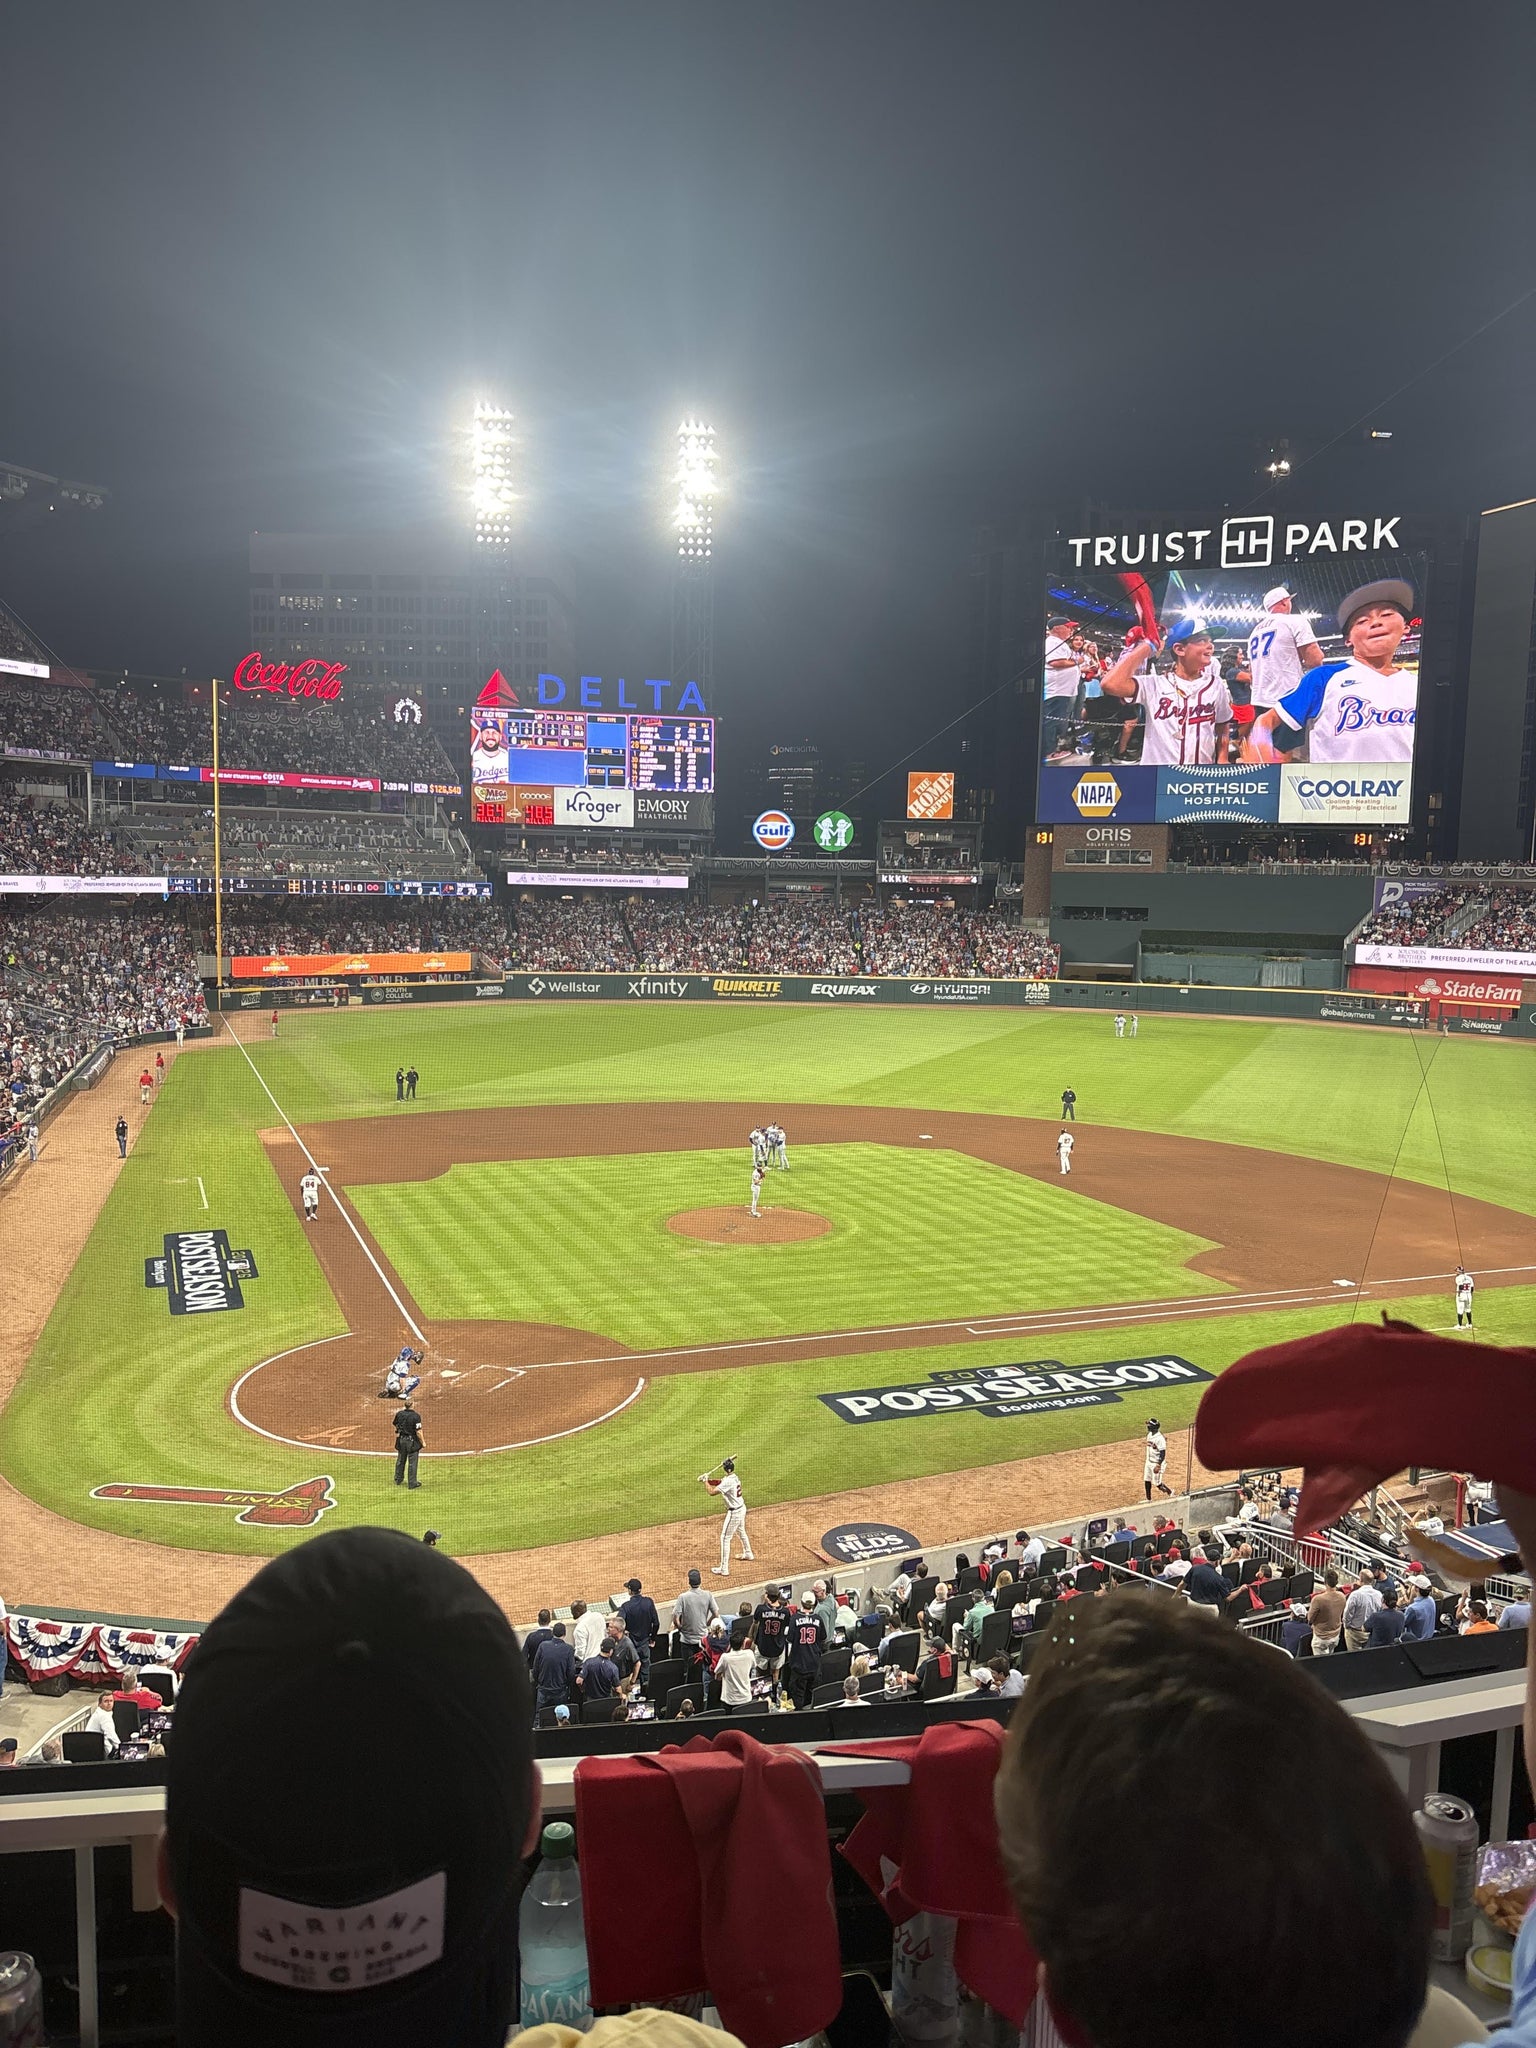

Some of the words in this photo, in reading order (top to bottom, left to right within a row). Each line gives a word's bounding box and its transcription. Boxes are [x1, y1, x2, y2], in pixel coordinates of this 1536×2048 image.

[1068, 529, 1211, 567] TRUIST
[1285, 517, 1402, 555] PARK
[1250, 629, 1277, 660] 27
[234, 652, 347, 699] Coca-Cola
[538, 674, 706, 712] DELTA
[912, 777, 932, 796] THE
[1166, 782, 1269, 795] NORTHSIDE
[1298, 780, 1404, 797] COOLRAY
[909, 773, 953, 818] HOME
[1080, 786, 1116, 804] NAPA
[1184, 796, 1249, 805] HOSPITAL
[476, 804, 504, 817] 364
[526, 805, 553, 819] 485
[566, 790, 622, 822] Kroger
[637, 800, 690, 813] EMORY
[925, 790, 952, 818] DEPOT
[756, 824, 790, 836] Gulf
[1086, 828, 1131, 841] ORIS
[548, 981, 600, 993] Wellstar
[628, 978, 689, 997] xfinity
[713, 979, 781, 992] QUIKRETE
[811, 984, 879, 995] EQUIFAX
[934, 984, 991, 995] HYUNDAI
[1026, 983, 1050, 992] PAPA
[1320, 1008, 1375, 1020] globalpayments
[1470, 1021, 1502, 1031] National
[178, 1232, 228, 1311] POSTSEASON
[938, 1371, 976, 1382] 20
[836, 1360, 1198, 1418] POSTSEASON
[996, 1394, 1102, 1414] Booking.com
[837, 1534, 903, 1553] NLDS
[765, 1620, 781, 1635] 13
[800, 1627, 816, 1644] 13
